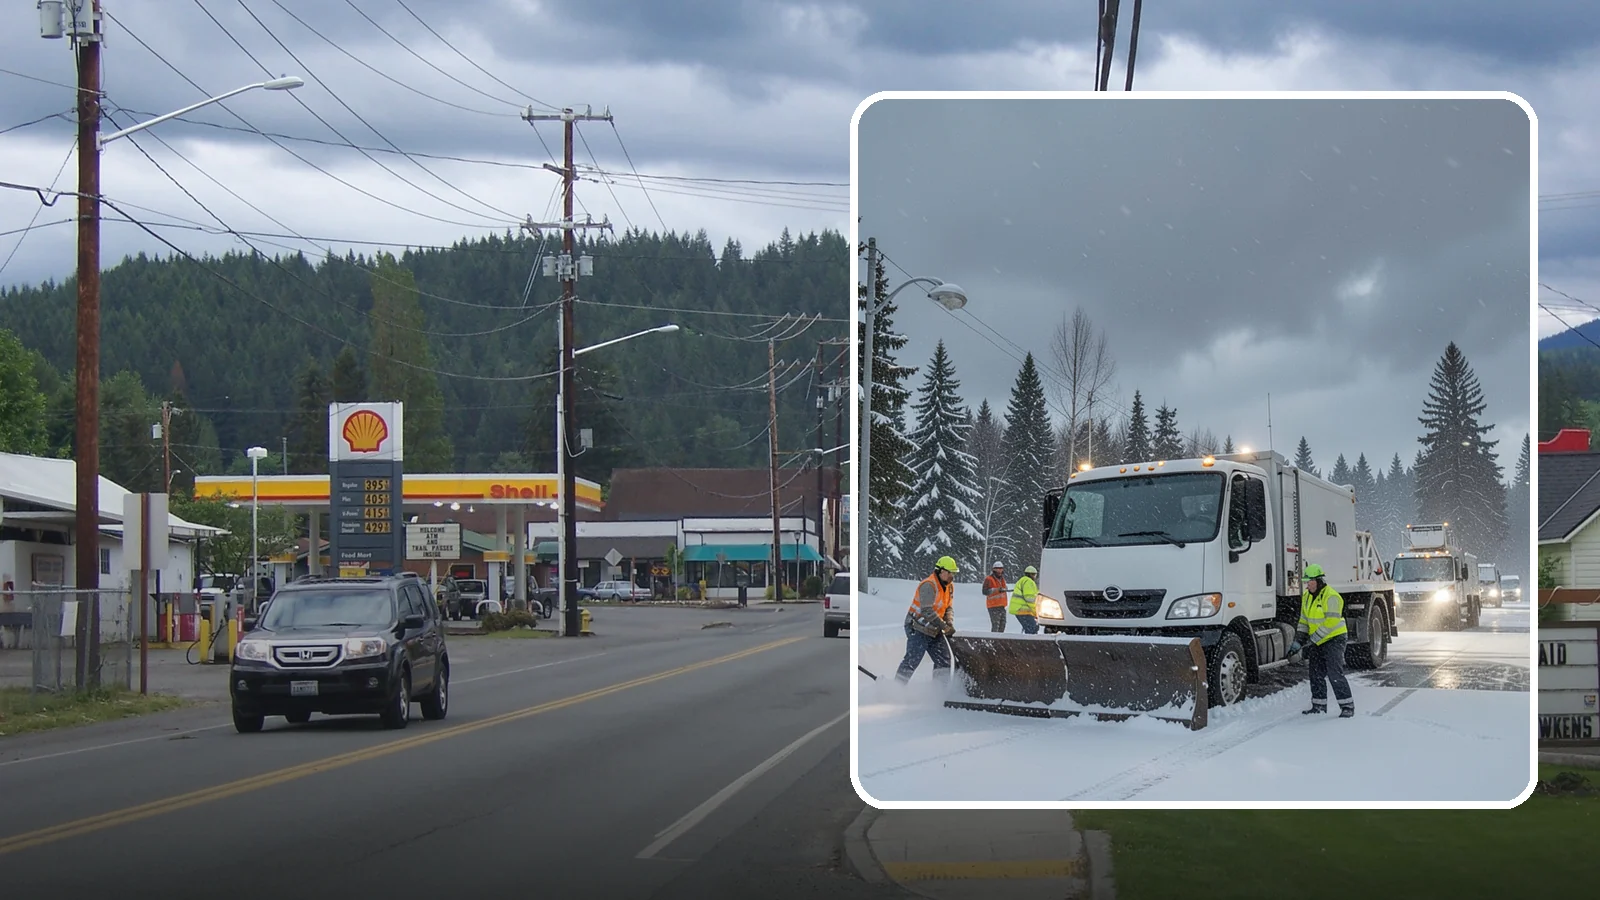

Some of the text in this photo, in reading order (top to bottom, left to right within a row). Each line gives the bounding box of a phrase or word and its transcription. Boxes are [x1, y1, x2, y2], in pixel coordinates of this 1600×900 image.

[366, 480, 384, 490] 395
[490, 484, 547, 499] Shell
[365, 494, 384, 504] 405
[365, 508, 384, 518] 415
[365, 522, 384, 532] 429
